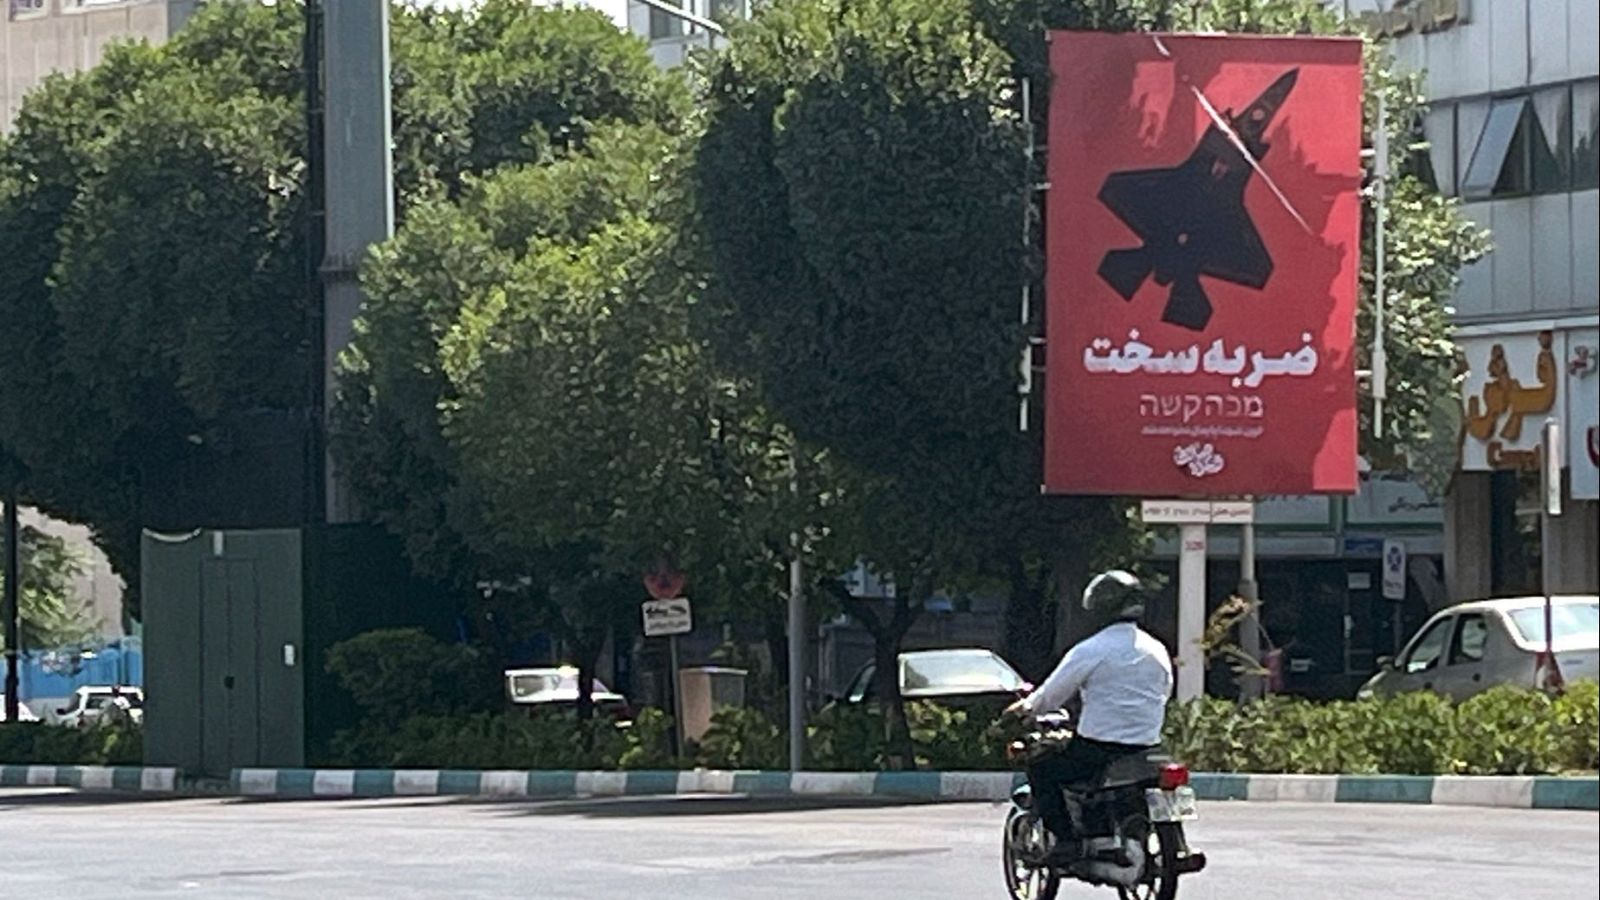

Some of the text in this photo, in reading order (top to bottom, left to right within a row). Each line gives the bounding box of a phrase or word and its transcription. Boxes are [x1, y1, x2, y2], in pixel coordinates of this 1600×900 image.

[1083, 328, 1319, 388] ضربه سخت
[1466, 330, 1557, 442] فرش
